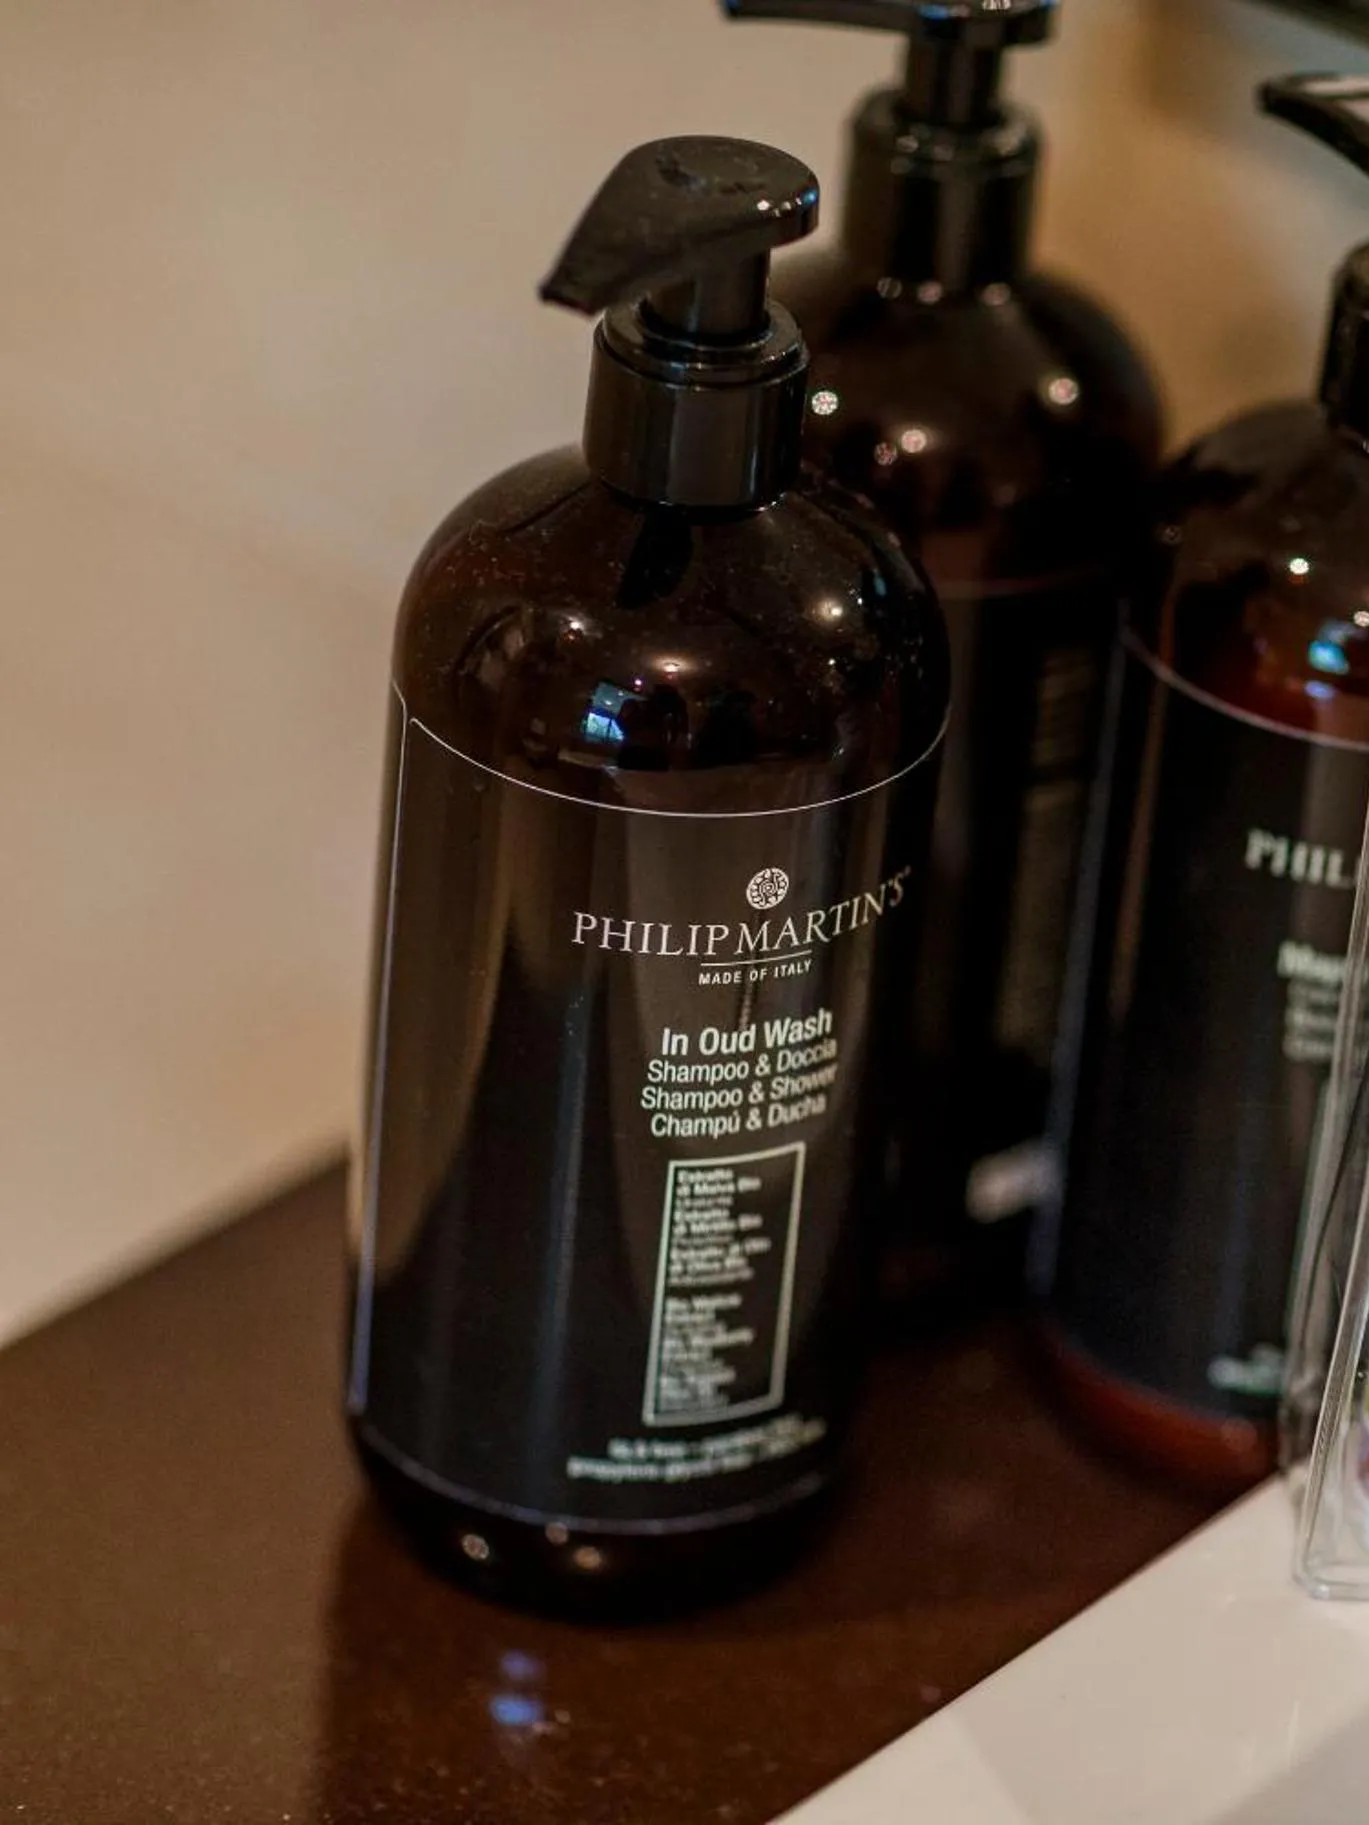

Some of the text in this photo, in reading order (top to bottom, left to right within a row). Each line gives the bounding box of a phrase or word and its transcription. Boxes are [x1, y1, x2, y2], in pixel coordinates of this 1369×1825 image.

[571, 875, 904, 956] PHILIP MARTIN'S
[698, 959, 813, 986] MADE OF ITALY
[661, 1007, 833, 1057] In Oud Wash
[647, 1038, 838, 1086] Shampoo & Doccia
[640, 1063, 839, 1114] Shampoo & Shower
[650, 1095, 827, 1139] Champú & Ducha
